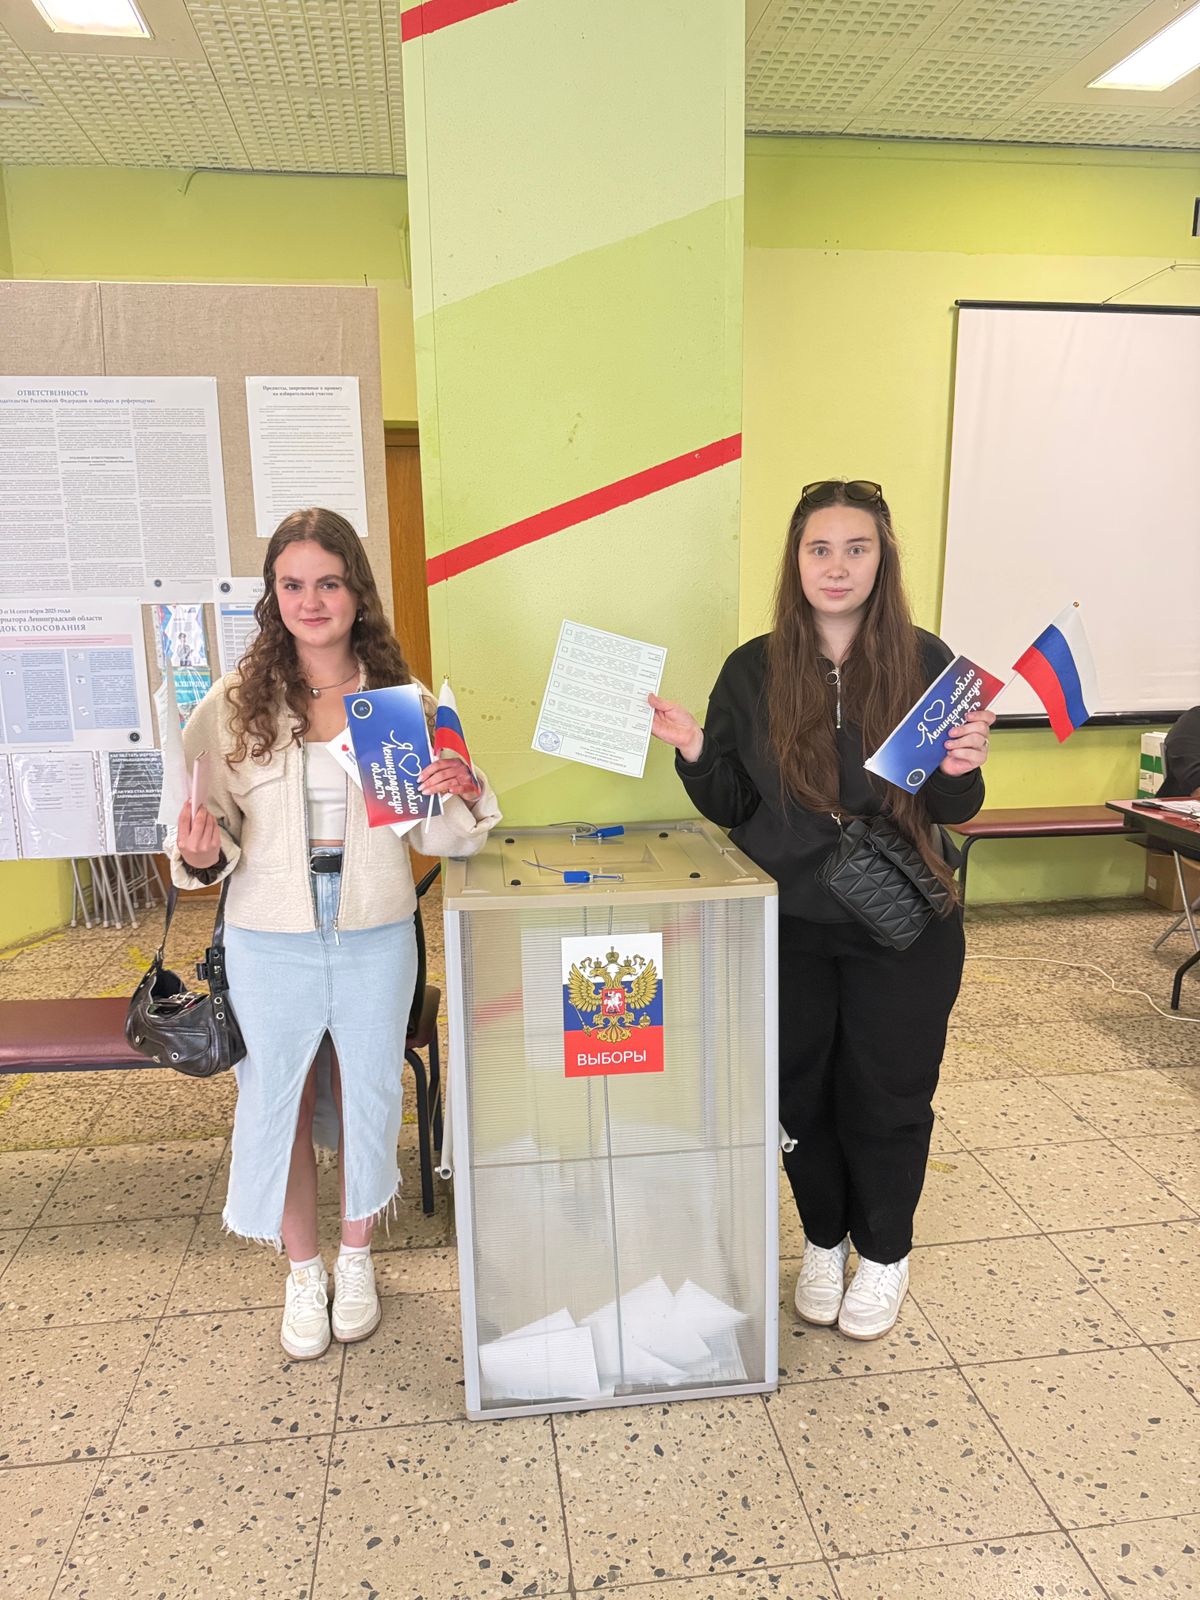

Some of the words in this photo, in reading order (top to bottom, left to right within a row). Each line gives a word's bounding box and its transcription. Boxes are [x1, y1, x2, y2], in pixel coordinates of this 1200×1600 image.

[17, 389, 89, 397] ОТВЕТСТВЕННОСТЬ
[16, 608, 44, 616] сентября
[28, 616, 76, 624] Ленинградской
[18, 624, 86, 632] ГОЛОСОВАНИЯ
[916, 721, 929, 748] Я
[950, 669, 976, 705] люблю
[926, 678, 983, 745] Ленинградскую
[371, 762, 386, 800] область
[381, 741, 404, 815] Ленинградскую
[389, 730, 414, 751] Я
[404, 779, 423, 815] люблю
[577, 1050, 647, 1067] ВЫБОРЫ
